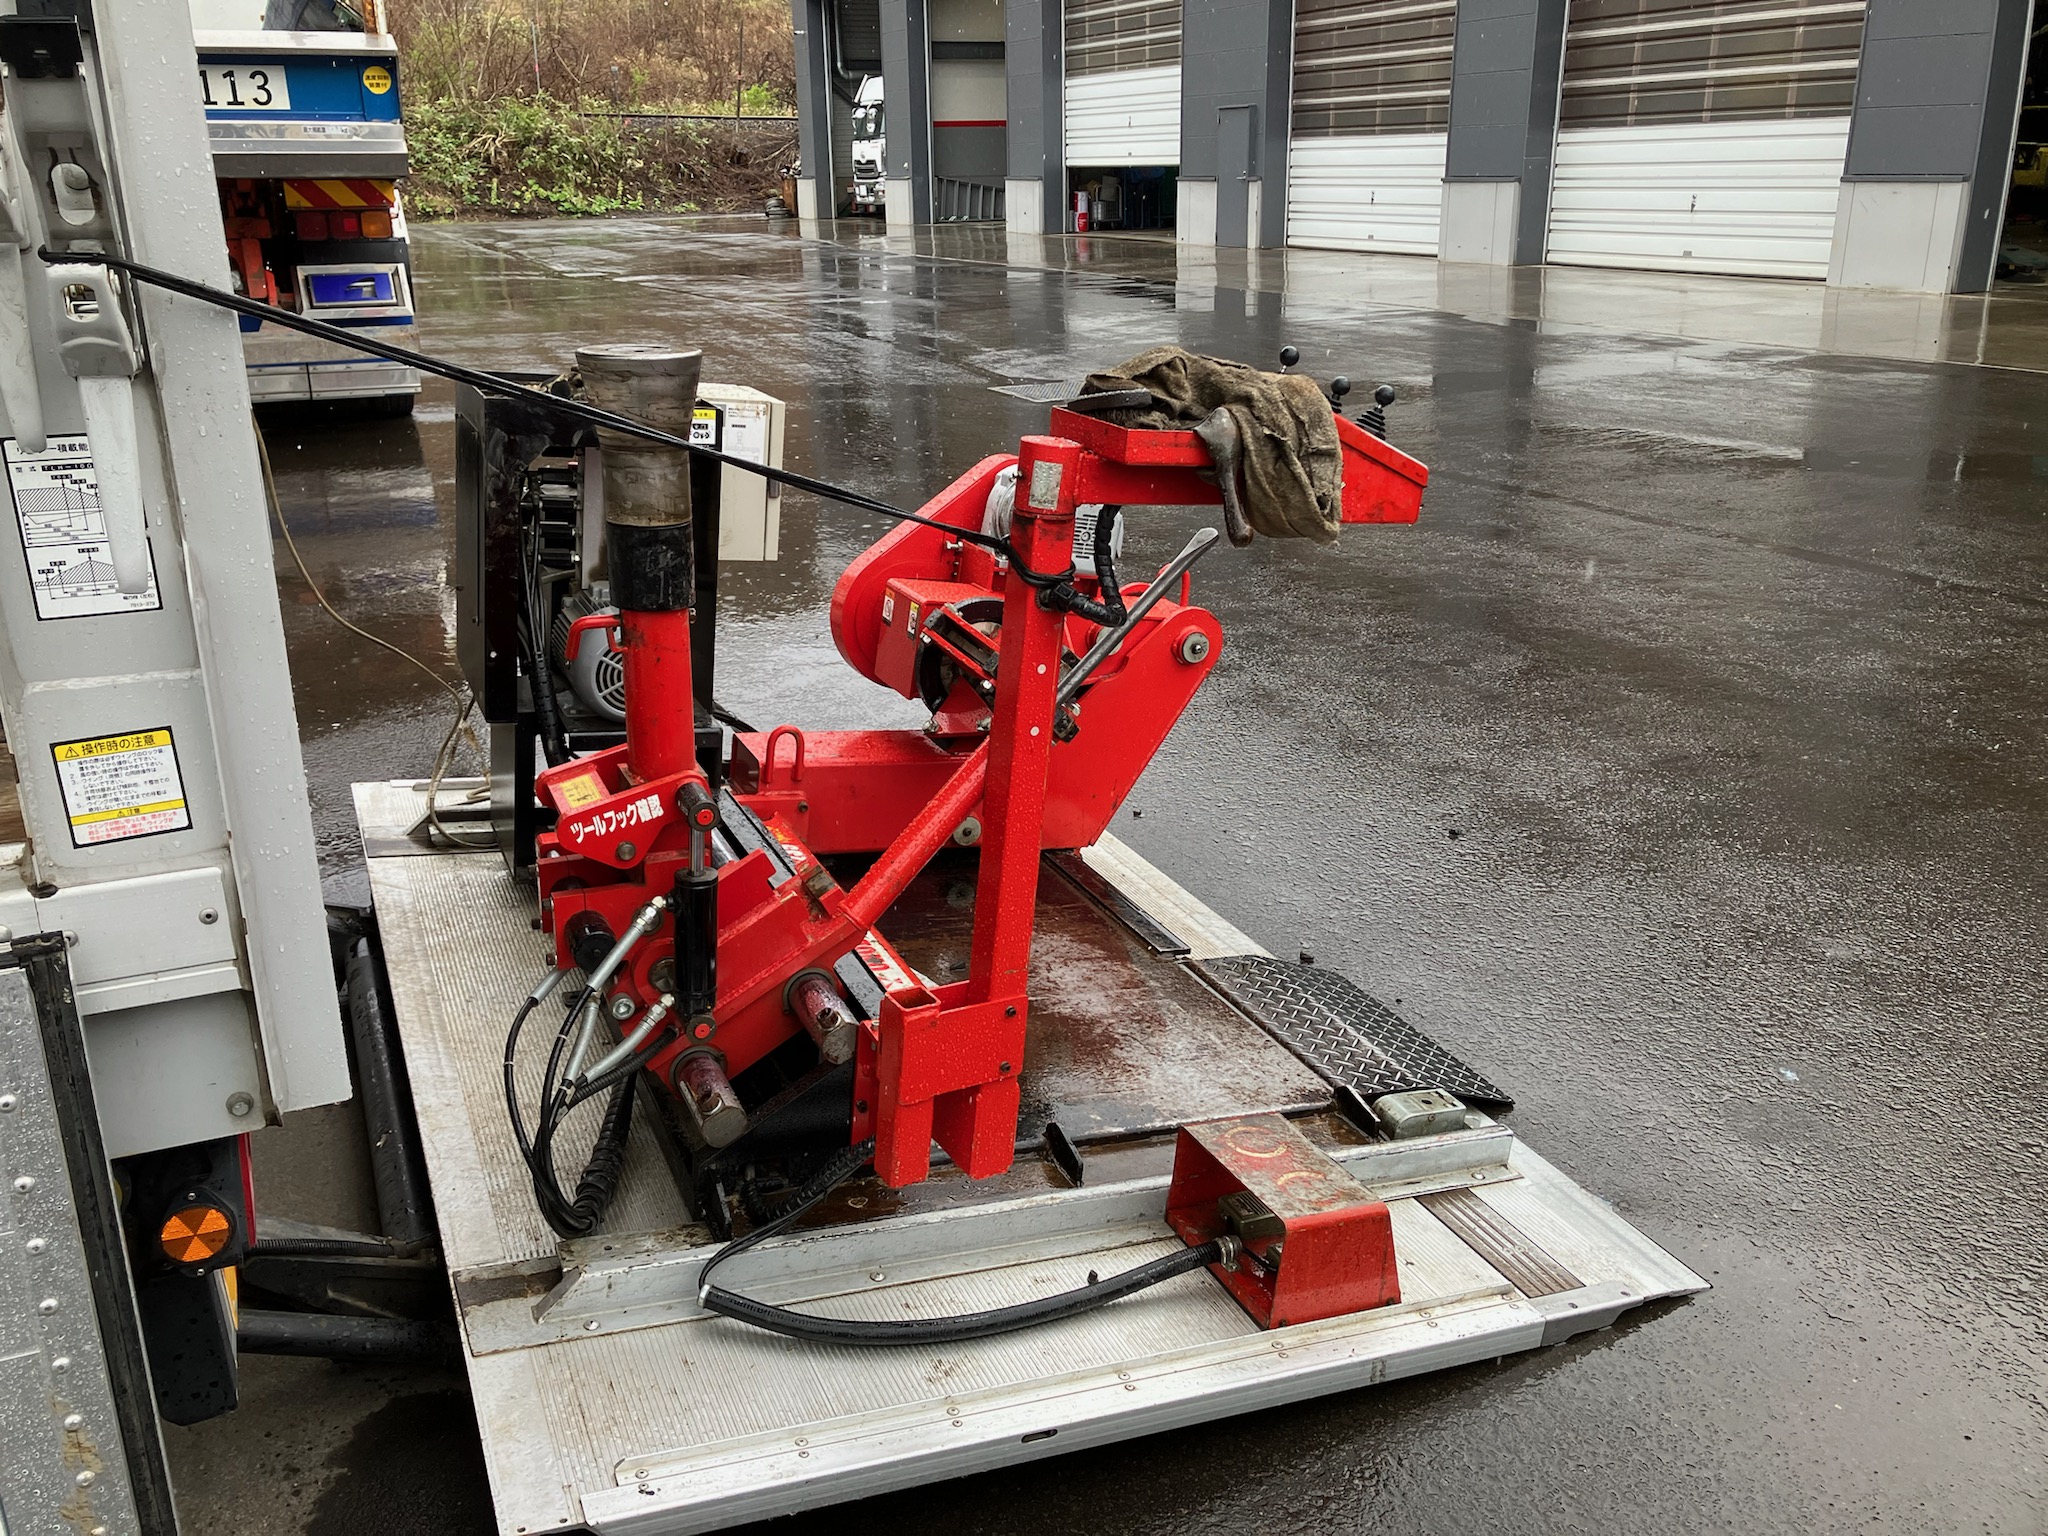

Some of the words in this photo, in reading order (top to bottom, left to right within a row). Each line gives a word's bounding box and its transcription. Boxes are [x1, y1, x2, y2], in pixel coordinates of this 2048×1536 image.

[81, 734, 155, 755] 操作時の注意
